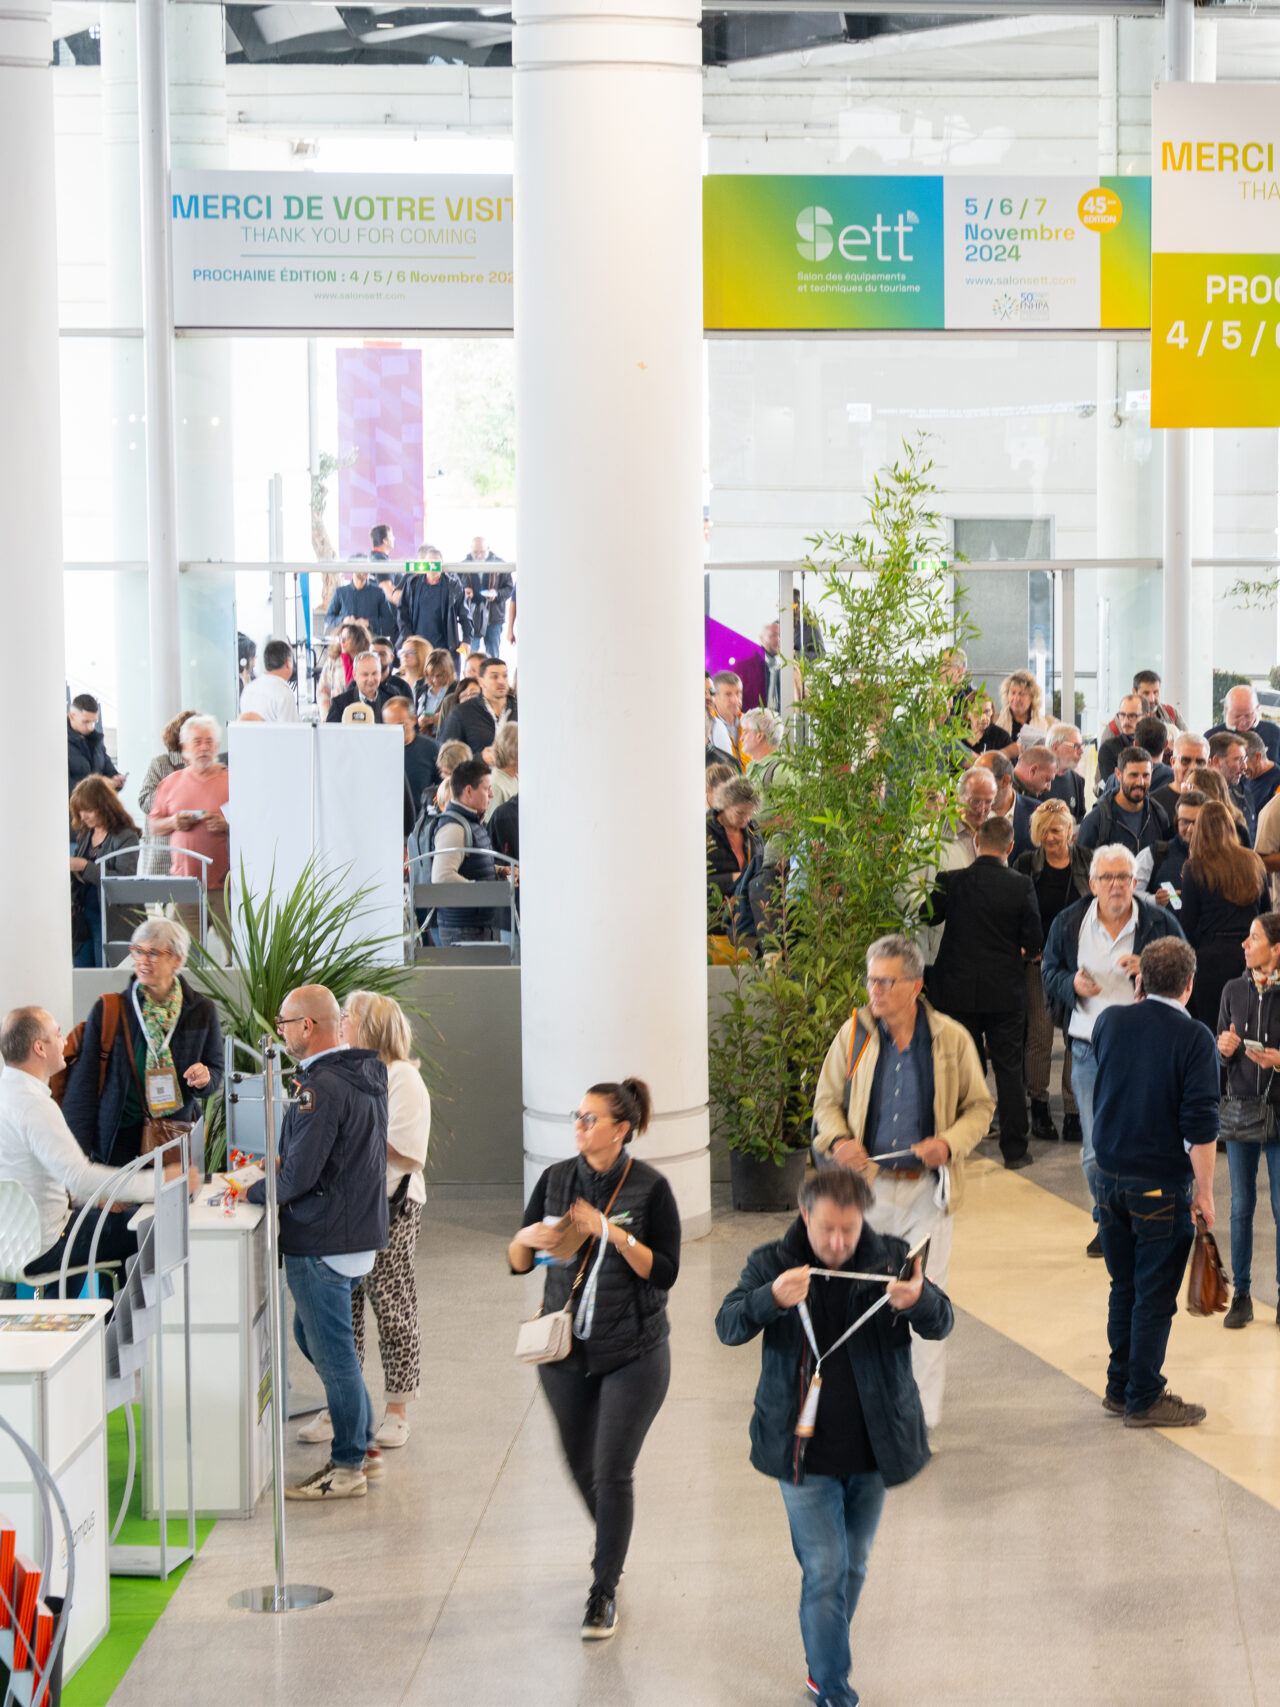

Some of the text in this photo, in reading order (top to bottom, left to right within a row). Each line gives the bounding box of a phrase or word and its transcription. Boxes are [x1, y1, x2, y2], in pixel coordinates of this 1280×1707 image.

[1162, 142, 1274, 173] MERCI
[172, 194, 513, 222] MERCI DE VOTRE VISIT
[965, 198, 1047, 220] 5 / 6 / 7
[241, 226, 477, 244] THANK YOU FOR COMING
[796, 206, 914, 262] Sett
[965, 224, 1076, 241] Novembre
[965, 244, 1021, 262] 2024
[193, 269, 276, 282] PROCHAINE
[280, 267, 337, 282] ÉDITION
[349, 271, 359, 282] 4
[363, 270, 370, 285] /
[373, 271, 383, 282] 5
[386, 270, 393, 285] /
[397, 271, 406, 282] 6
[410, 271, 484, 283] Novembre
[488, 271, 513, 284] 202
[797, 271, 906, 283] Salon des équipements
[965, 275, 1077, 286] www.salonsett.com
[797, 284, 921, 294] et techniques du tourisme
[1166, 320, 1188, 349] 4
[1197, 320, 1213, 357] /
[1222, 320, 1241, 350] 5
[1250, 320, 1266, 357] /
